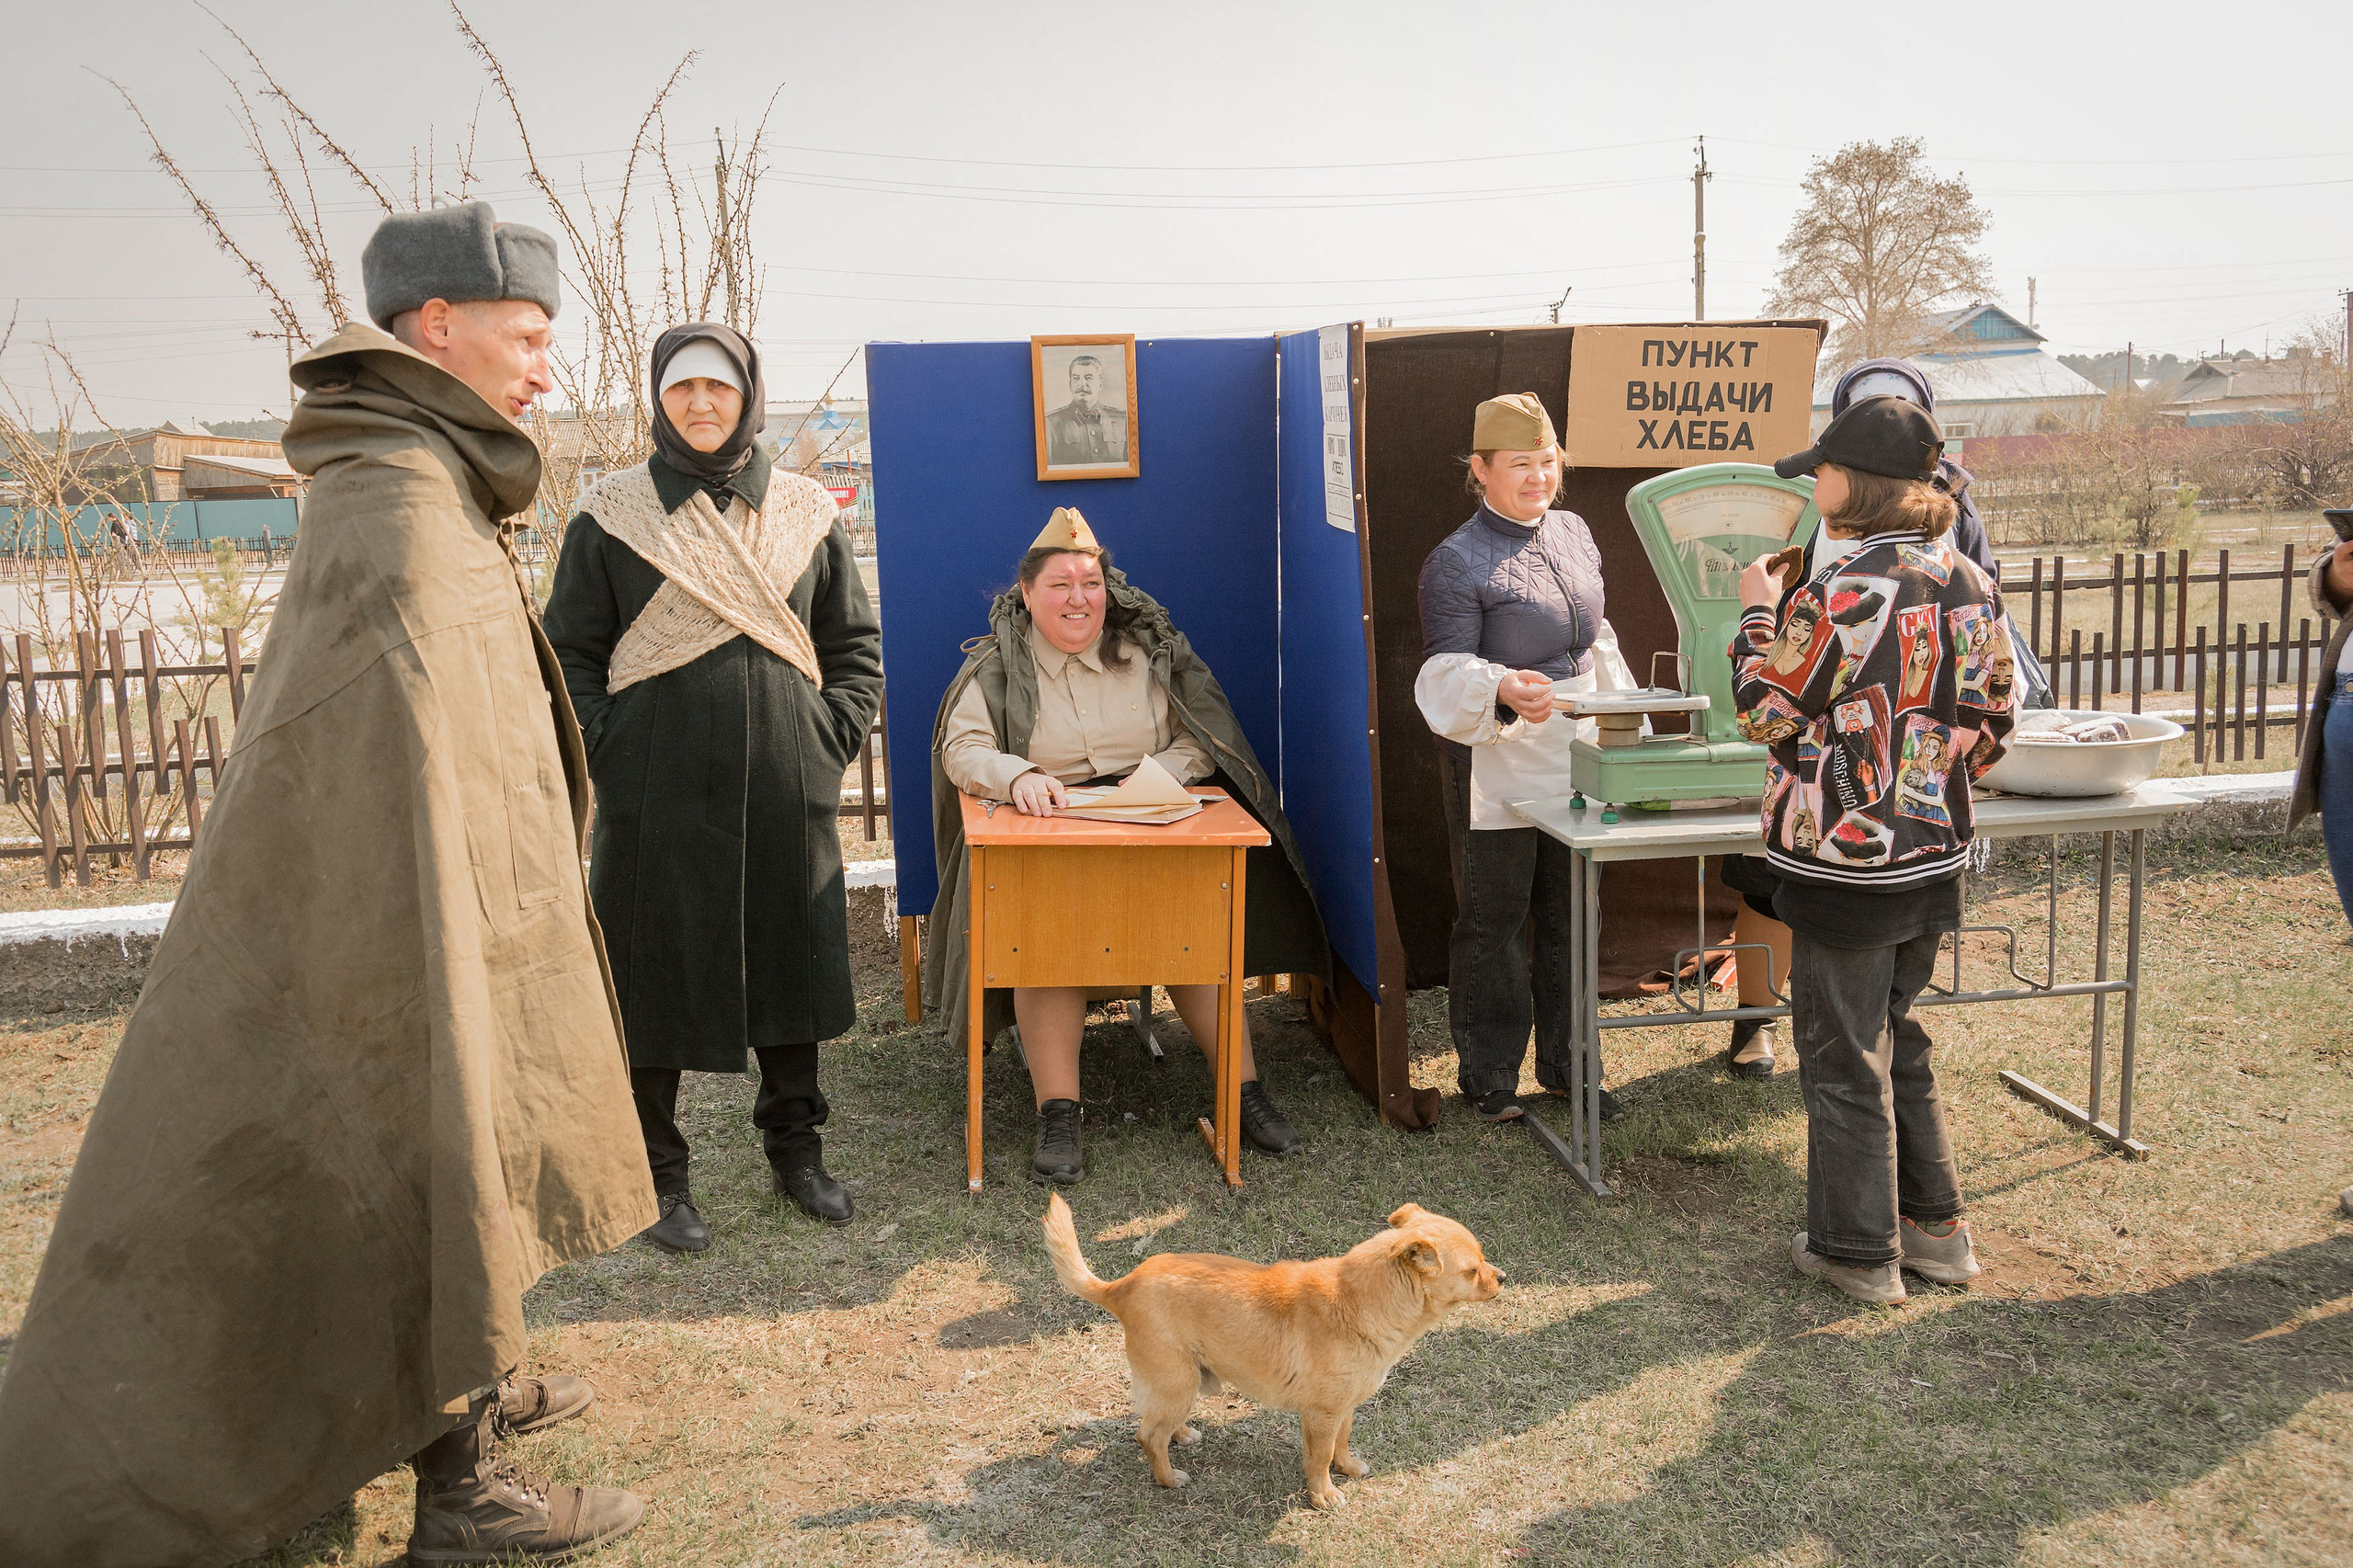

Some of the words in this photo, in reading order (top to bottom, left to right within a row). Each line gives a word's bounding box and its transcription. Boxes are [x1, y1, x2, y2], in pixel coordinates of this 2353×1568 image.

[1642, 340, 1758, 368] ПУНКТ
[1626, 381, 1773, 416] ВЫДАЧИ
[1636, 419, 1755, 450] ХЛЕБА
[1834, 743, 1858, 809] MOSCHINO
